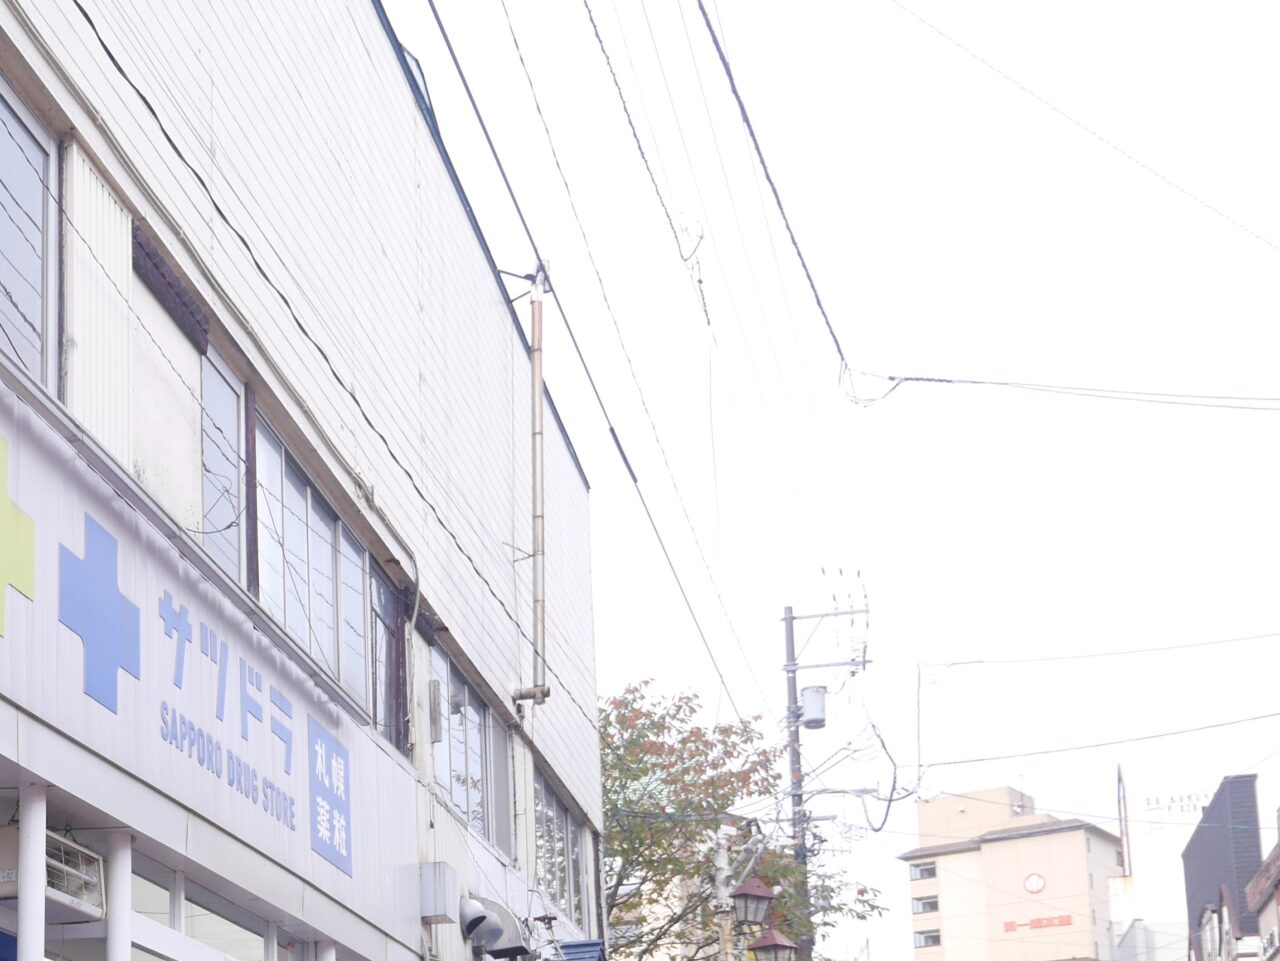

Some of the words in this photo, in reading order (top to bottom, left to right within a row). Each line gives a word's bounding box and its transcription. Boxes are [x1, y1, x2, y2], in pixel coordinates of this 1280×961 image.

[158, 589, 293, 776] サツドラ
[160, 701, 223, 779] SAPPORO
[226, 749, 258, 805] DRUG
[262, 776, 296, 832] STORE
